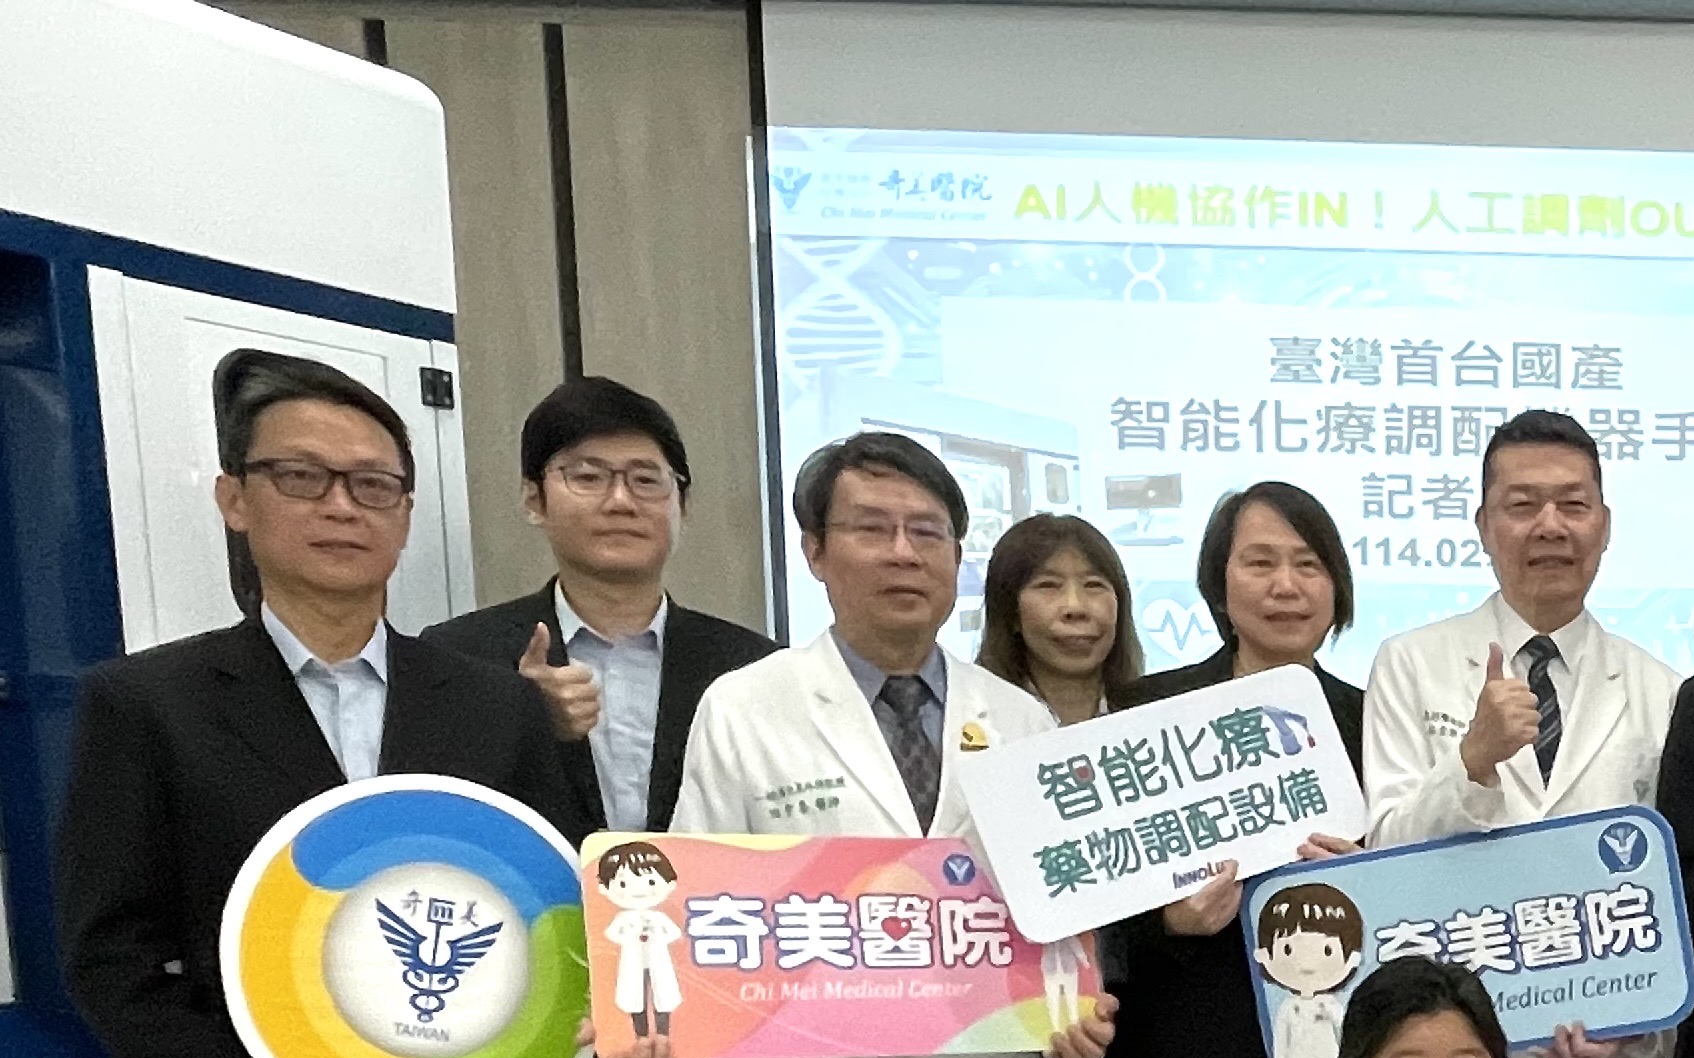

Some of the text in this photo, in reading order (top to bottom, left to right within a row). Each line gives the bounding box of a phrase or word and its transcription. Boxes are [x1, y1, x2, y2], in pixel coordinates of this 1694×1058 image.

[1269, 336, 1624, 391] 臺灣首台國產
[1037, 705, 1281, 820] 智能化療
[1033, 767, 1328, 898] 藥物調配設備
[686, 891, 1015, 971] 奇美醫院
[740, 978, 974, 1003] Chi Mei Medical Center
[1581, 970, 1659, 999] Center
[394, 1022, 451, 1043] TAIWAN
